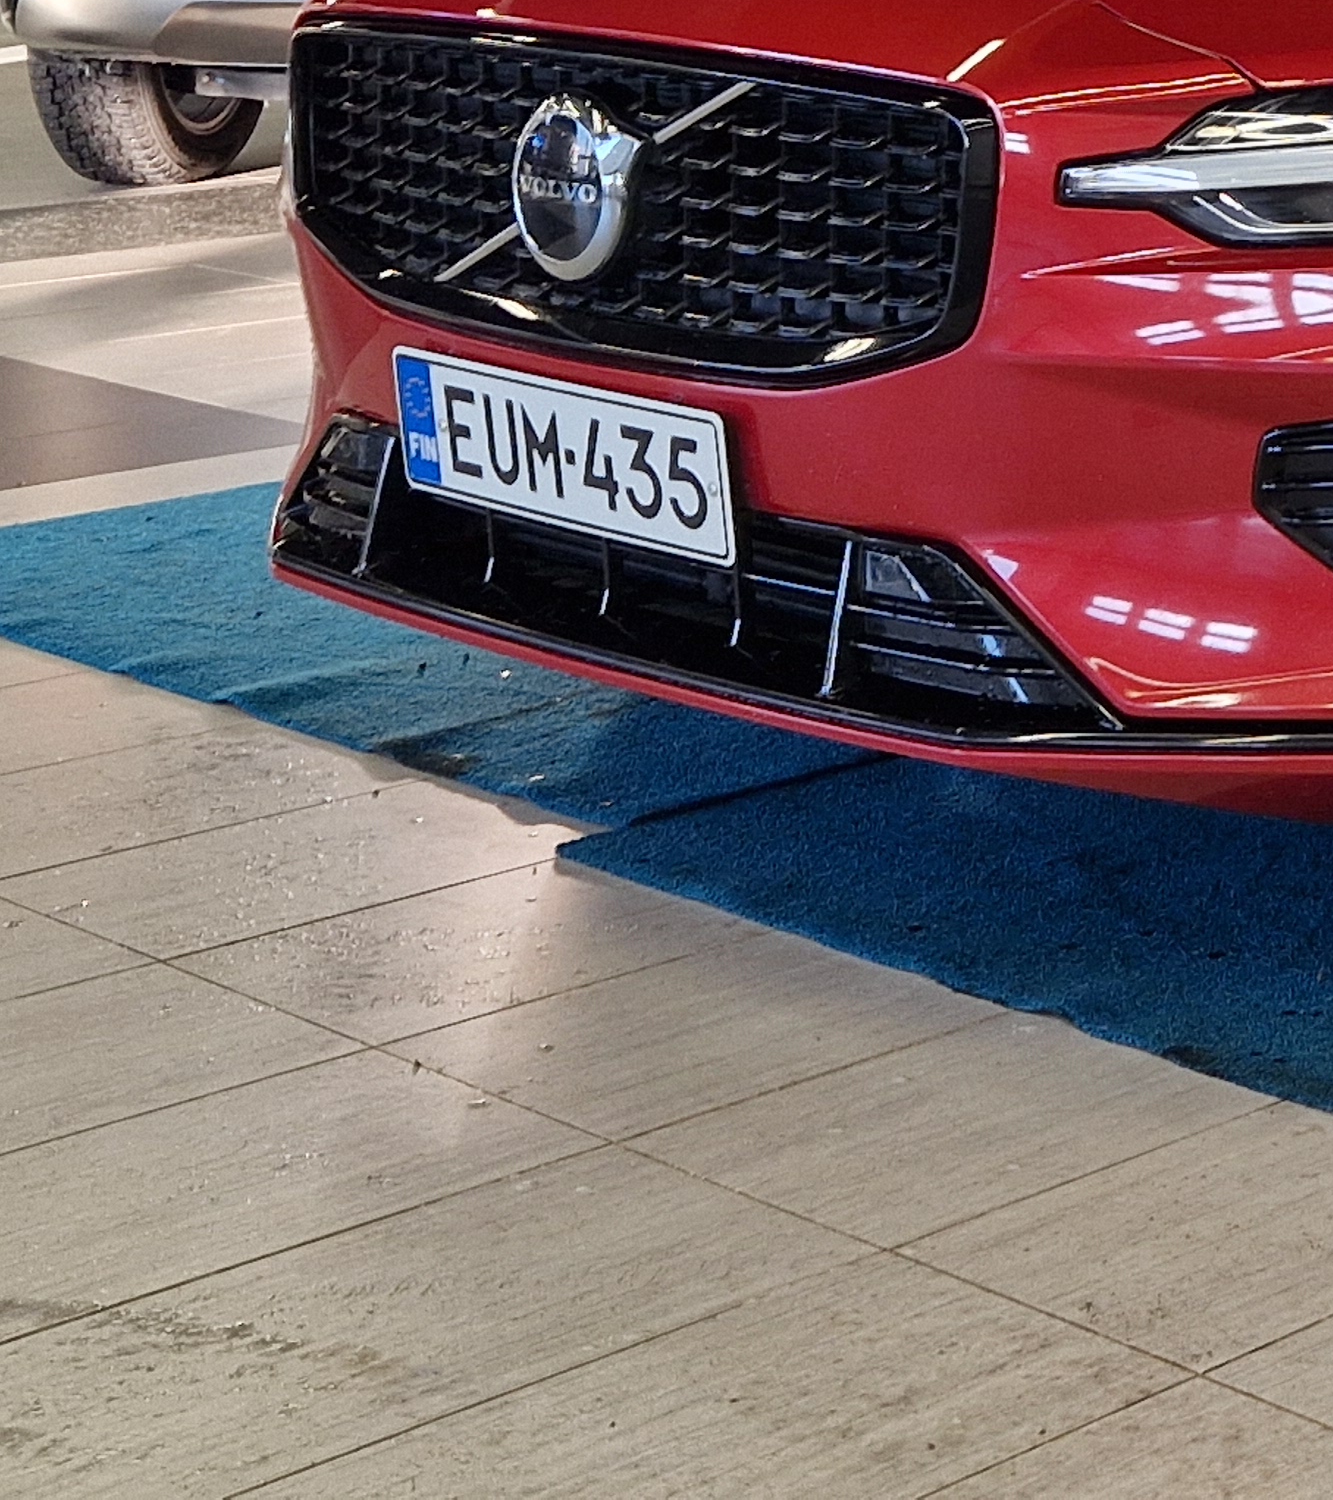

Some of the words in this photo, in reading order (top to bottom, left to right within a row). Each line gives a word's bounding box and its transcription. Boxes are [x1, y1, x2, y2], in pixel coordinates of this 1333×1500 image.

[519, 173, 598, 204] VOLVO
[408, 430, 439, 464] FIN
[444, 384, 708, 530] EUM-435
